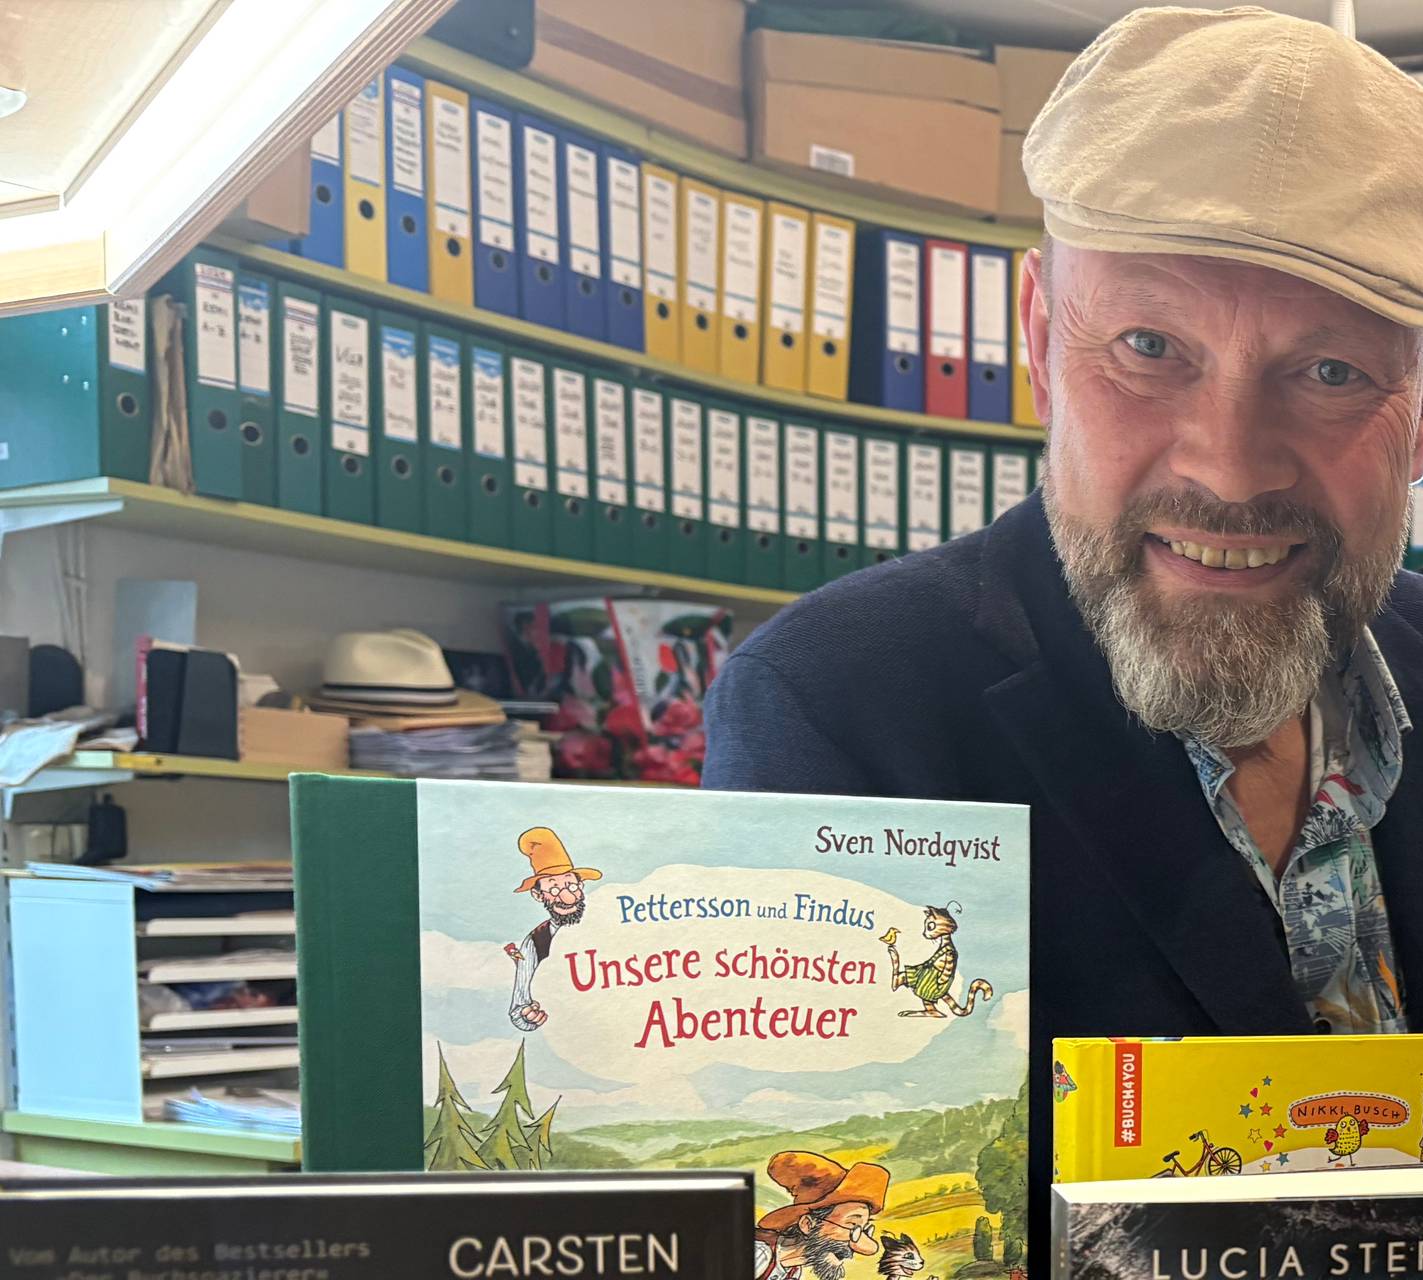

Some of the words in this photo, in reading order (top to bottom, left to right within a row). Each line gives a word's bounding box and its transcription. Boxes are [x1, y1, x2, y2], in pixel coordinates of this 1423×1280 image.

[814, 826, 874, 855] Sven
[884, 827, 1001, 868] Nordqvist
[617, 893, 752, 926] Pettersson
[756, 901, 787, 920] und
[793, 893, 876, 931] Findus
[565, 949, 700, 991] Unsere
[714, 943, 877, 987] schönsten
[634, 997, 857, 1048] Abenteuer
[1120, 1053, 1137, 1144] #BUCH4YOU
[1297, 1103, 1345, 1118] NIKKI
[1354, 1104, 1401, 1120] BUSCH
[67, 1245, 142, 1264] Autor
[155, 1245, 200, 1263] des
[213, 1238, 371, 1261] Bestsellers
[449, 1232, 679, 1279] CARSTEN
[1151, 1244, 1305, 1280] LUCIA
